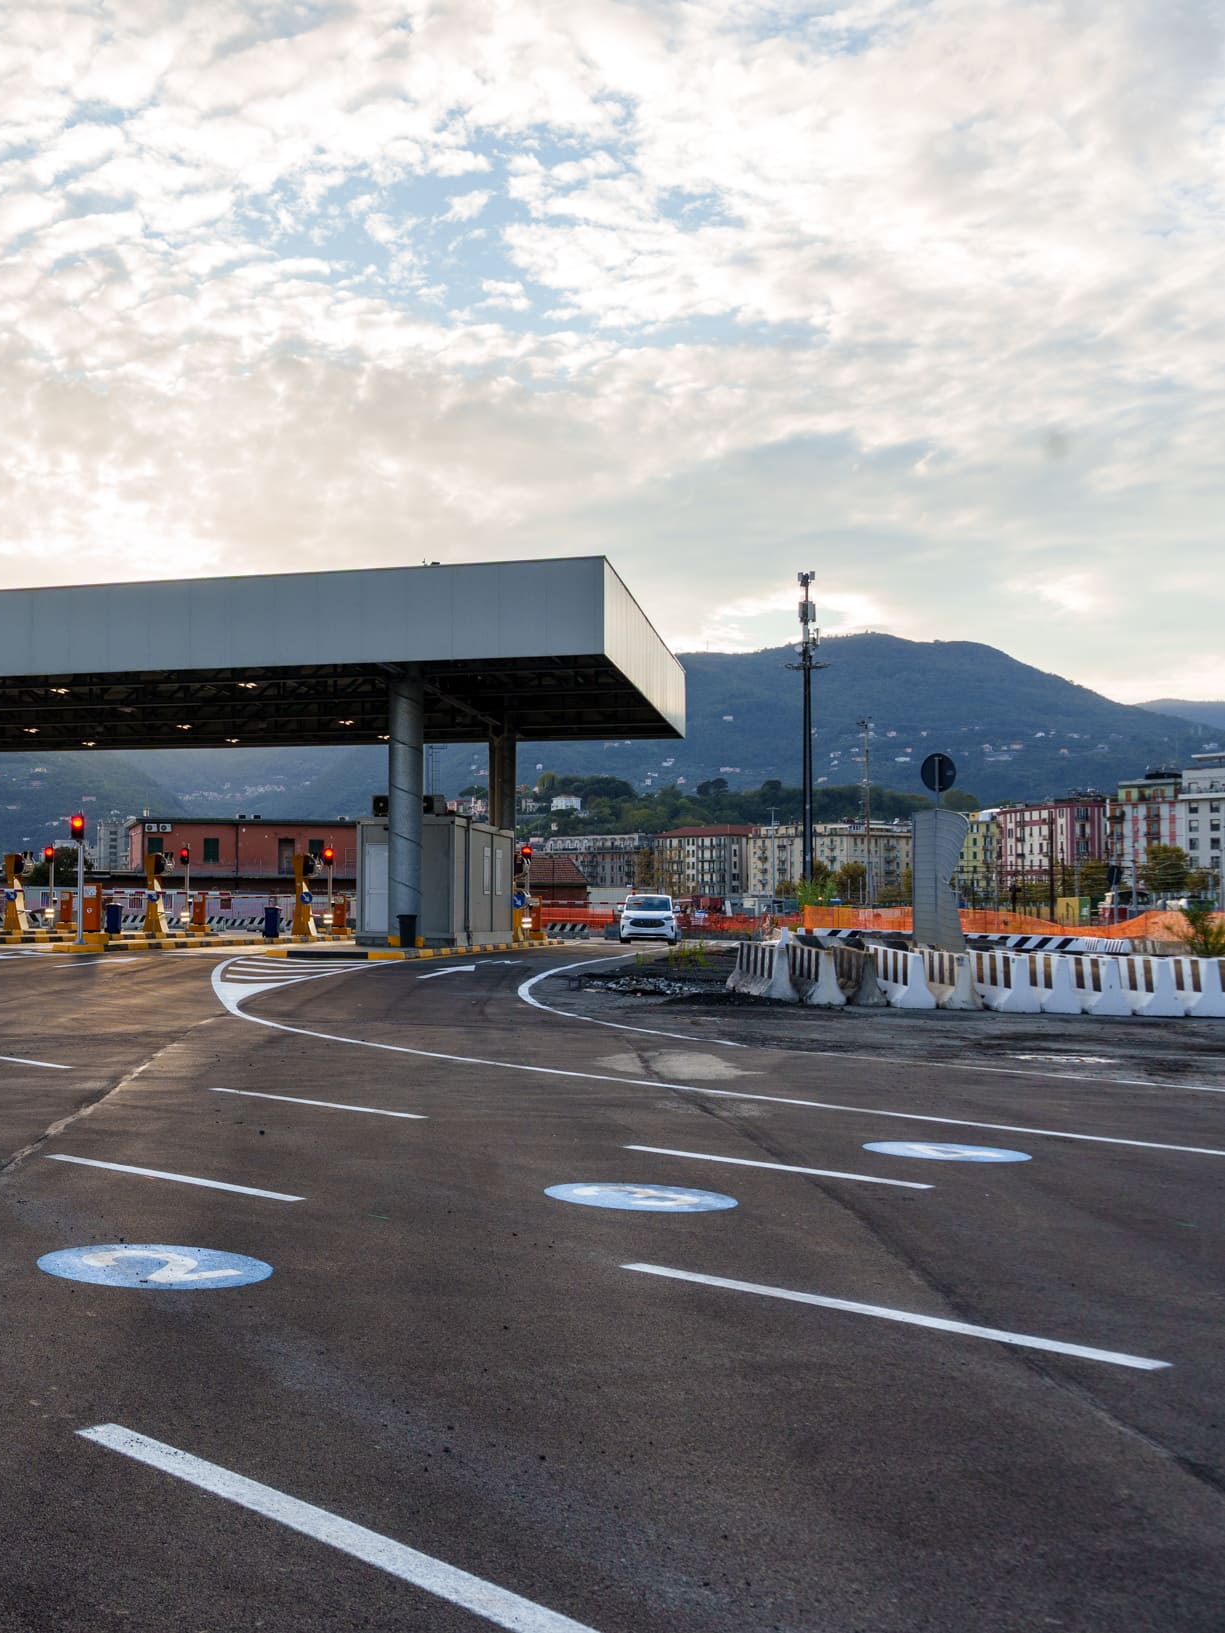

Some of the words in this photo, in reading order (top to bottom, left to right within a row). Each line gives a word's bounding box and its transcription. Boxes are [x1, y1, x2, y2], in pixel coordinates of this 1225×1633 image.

[905, 1144, 1007, 1158] 4
[573, 1186, 700, 1207] 3
[82, 1250, 243, 1283] 2
